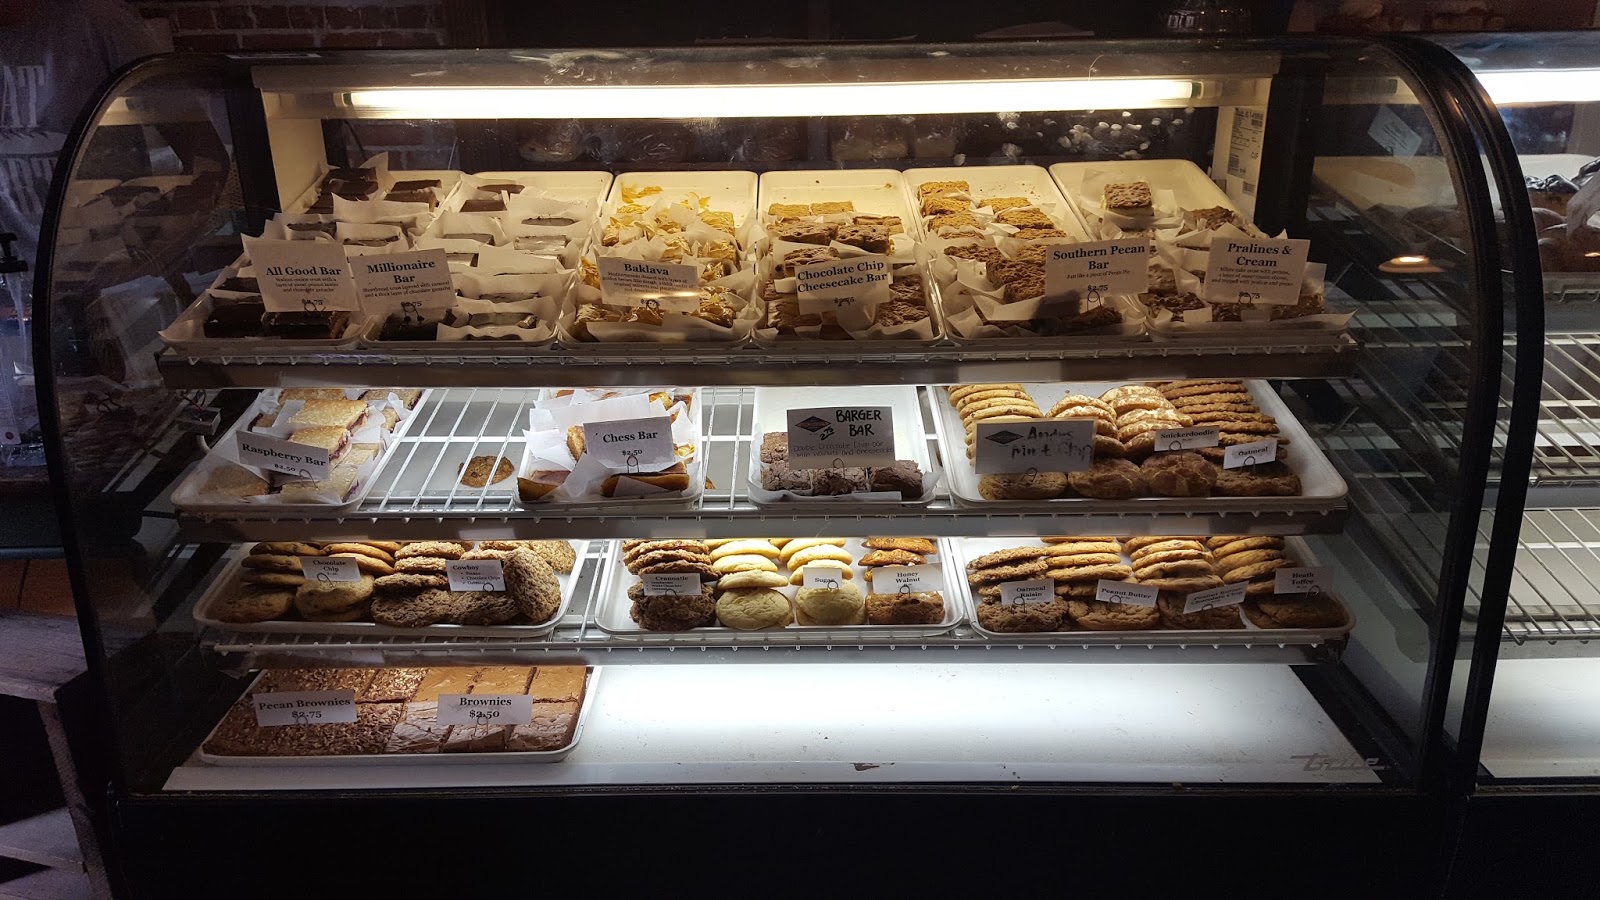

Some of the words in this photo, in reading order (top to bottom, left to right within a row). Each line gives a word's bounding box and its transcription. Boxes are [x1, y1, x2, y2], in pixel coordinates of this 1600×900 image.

[1053, 248, 1107, 260] Southern
[1110, 245, 1145, 255] Pecan
[1227, 243, 1280, 254] Pralines
[1281, 245, 1292, 255] &
[1088, 260, 1110, 270] Bar
[1236, 256, 1277, 267] Cream
[266, 266, 283, 276] All
[285, 266, 317, 276] Good
[319, 266, 342, 276] Bar
[367, 260, 436, 274] Millionaire
[624, 263, 669, 276] Baklava
[797, 266, 855, 281] Chocolate
[857, 260, 884, 272] Chip
[393, 274, 416, 284] Bar
[797, 276, 864, 293] Cheesecake
[866, 273, 887, 283] Bar
[1087, 284, 1109, 292] $2.75
[1238, 291, 1261, 299] $275
[301, 298, 323, 306] $275
[400, 300, 423, 308] $275
[835, 409, 882, 423] BARGER
[849, 423, 875, 437] BAR
[1160, 430, 1215, 439] Snickerdoodle
[603, 433, 636, 443] Chess
[637, 431, 658, 440] Bar
[242, 443, 302, 463] Raspberry
[304, 455, 327, 467] Bar
[621, 449, 643, 457] $2.50
[1238, 446, 1268, 456] Oatmeal
[274, 463, 296, 472] $2.50
[1101, 588, 1126, 596] Peanut
[1128, 591, 1152, 599] Butter
[1194, 592, 1219, 601] Peanut
[1191, 595, 1226, 605] Chocolate
[258, 701, 294, 710] Pecan
[296, 698, 351, 708] Brownies
[459, 697, 512, 706] Brownies
[291, 710, 322, 719] $2.75
[469, 709, 500, 719] $2.50
